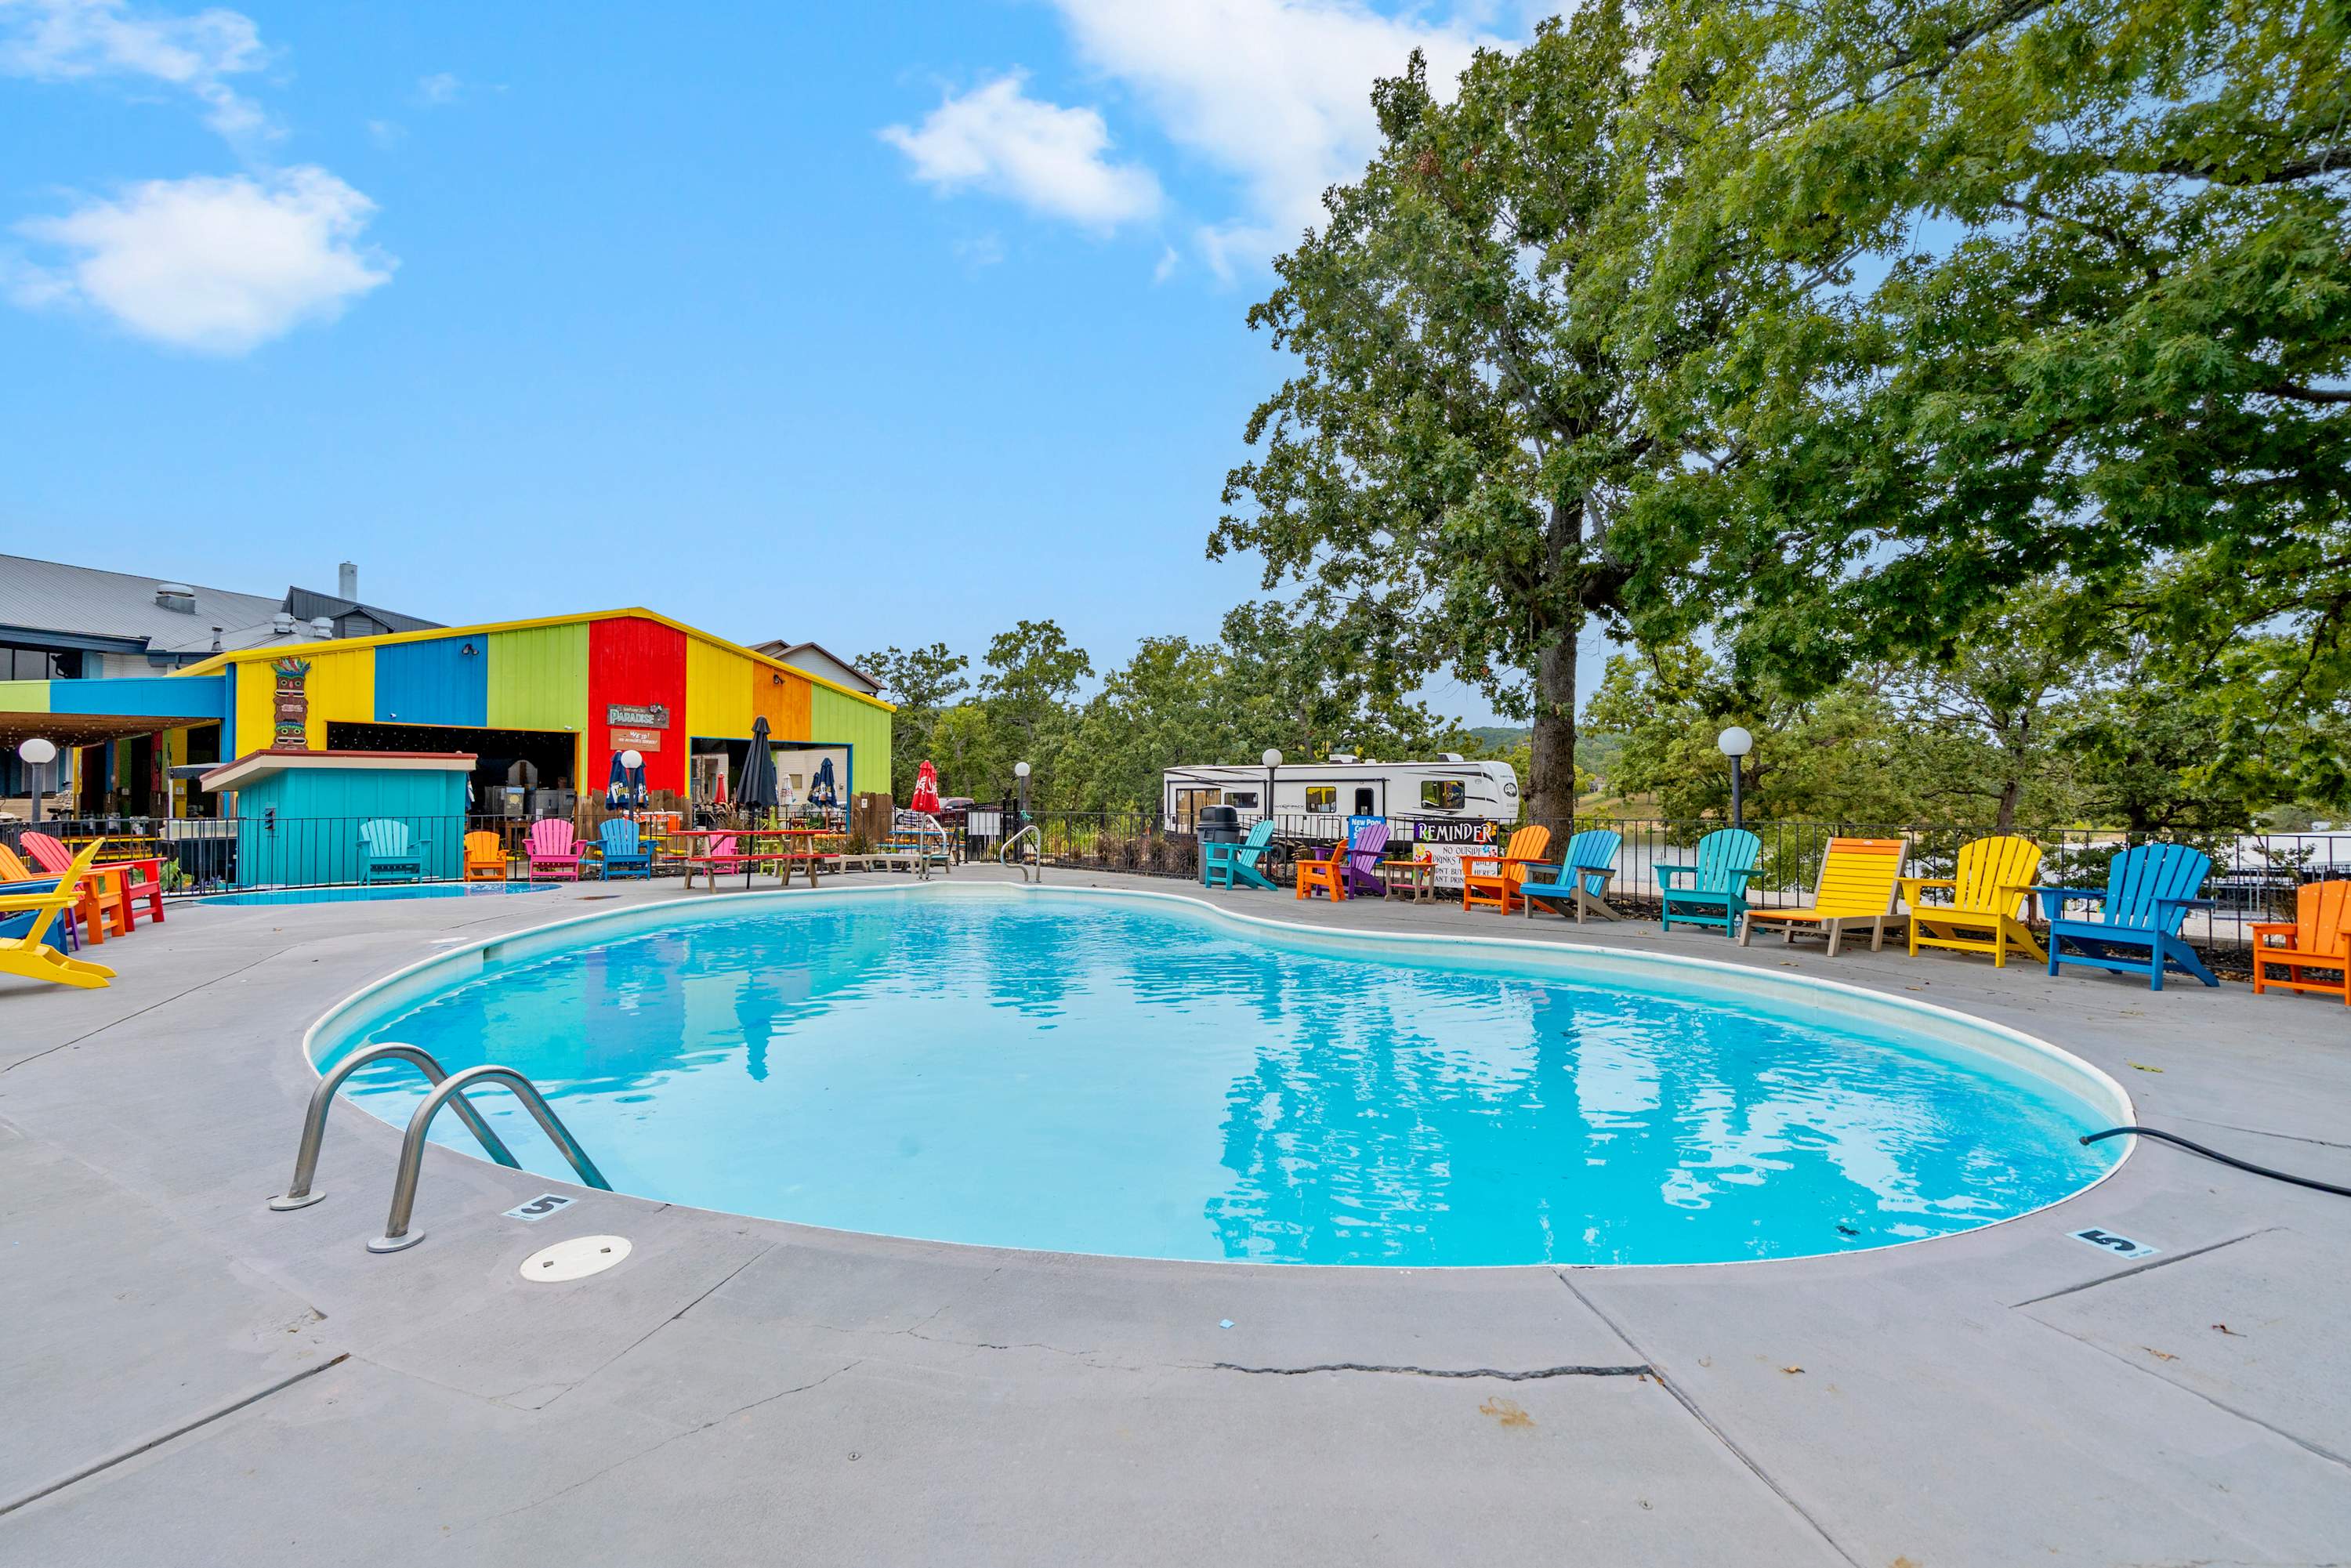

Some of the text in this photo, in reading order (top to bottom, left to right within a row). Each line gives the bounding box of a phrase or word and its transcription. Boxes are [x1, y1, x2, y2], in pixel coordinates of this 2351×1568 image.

[610, 709, 654, 724] PARADISE
[629, 730, 640, 739] WE
[1418, 823, 1493, 842] REMINDER
[1433, 855, 1455, 865] DRINKS
[521, 1196, 569, 1215] 5
[2078, 1229, 2136, 1251] 5
